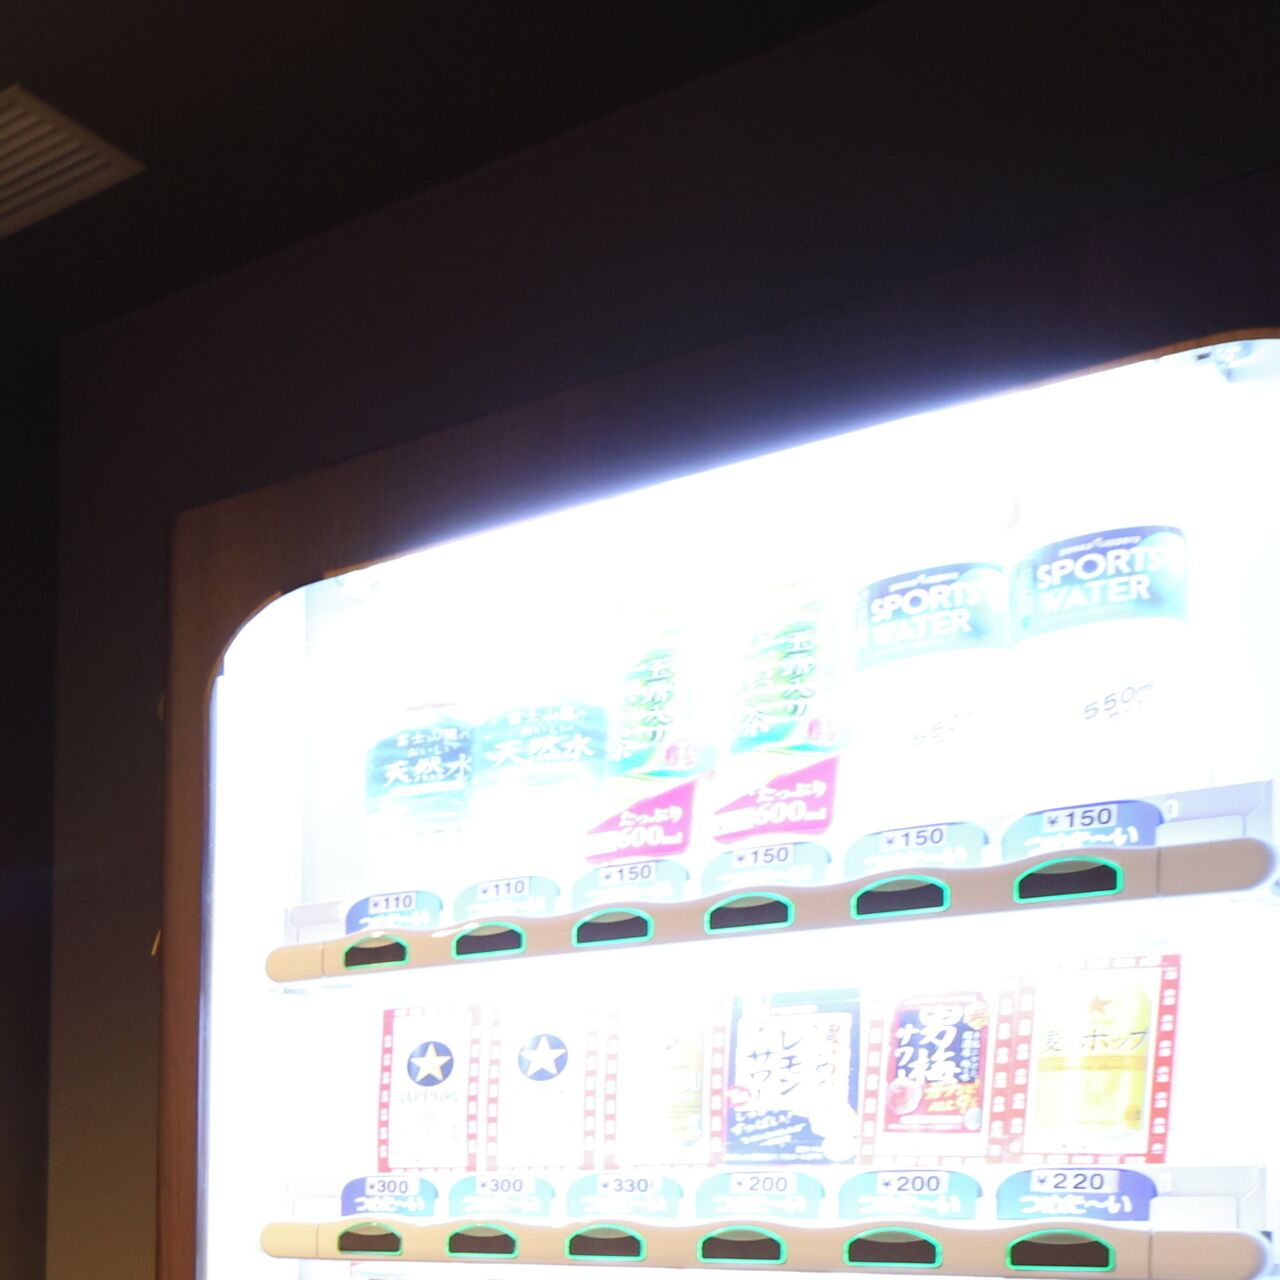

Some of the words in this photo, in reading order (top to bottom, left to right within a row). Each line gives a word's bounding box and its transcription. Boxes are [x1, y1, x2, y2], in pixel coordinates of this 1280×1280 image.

[1036, 546, 1164, 589] SPORTS
[870, 581, 985, 624] SPORTS
[1038, 574, 1152, 613] WATER
[383, 754, 472, 786] 天然水
[746, 1049, 775, 1103] サワー
[781, 1029, 804, 1097] レモン
